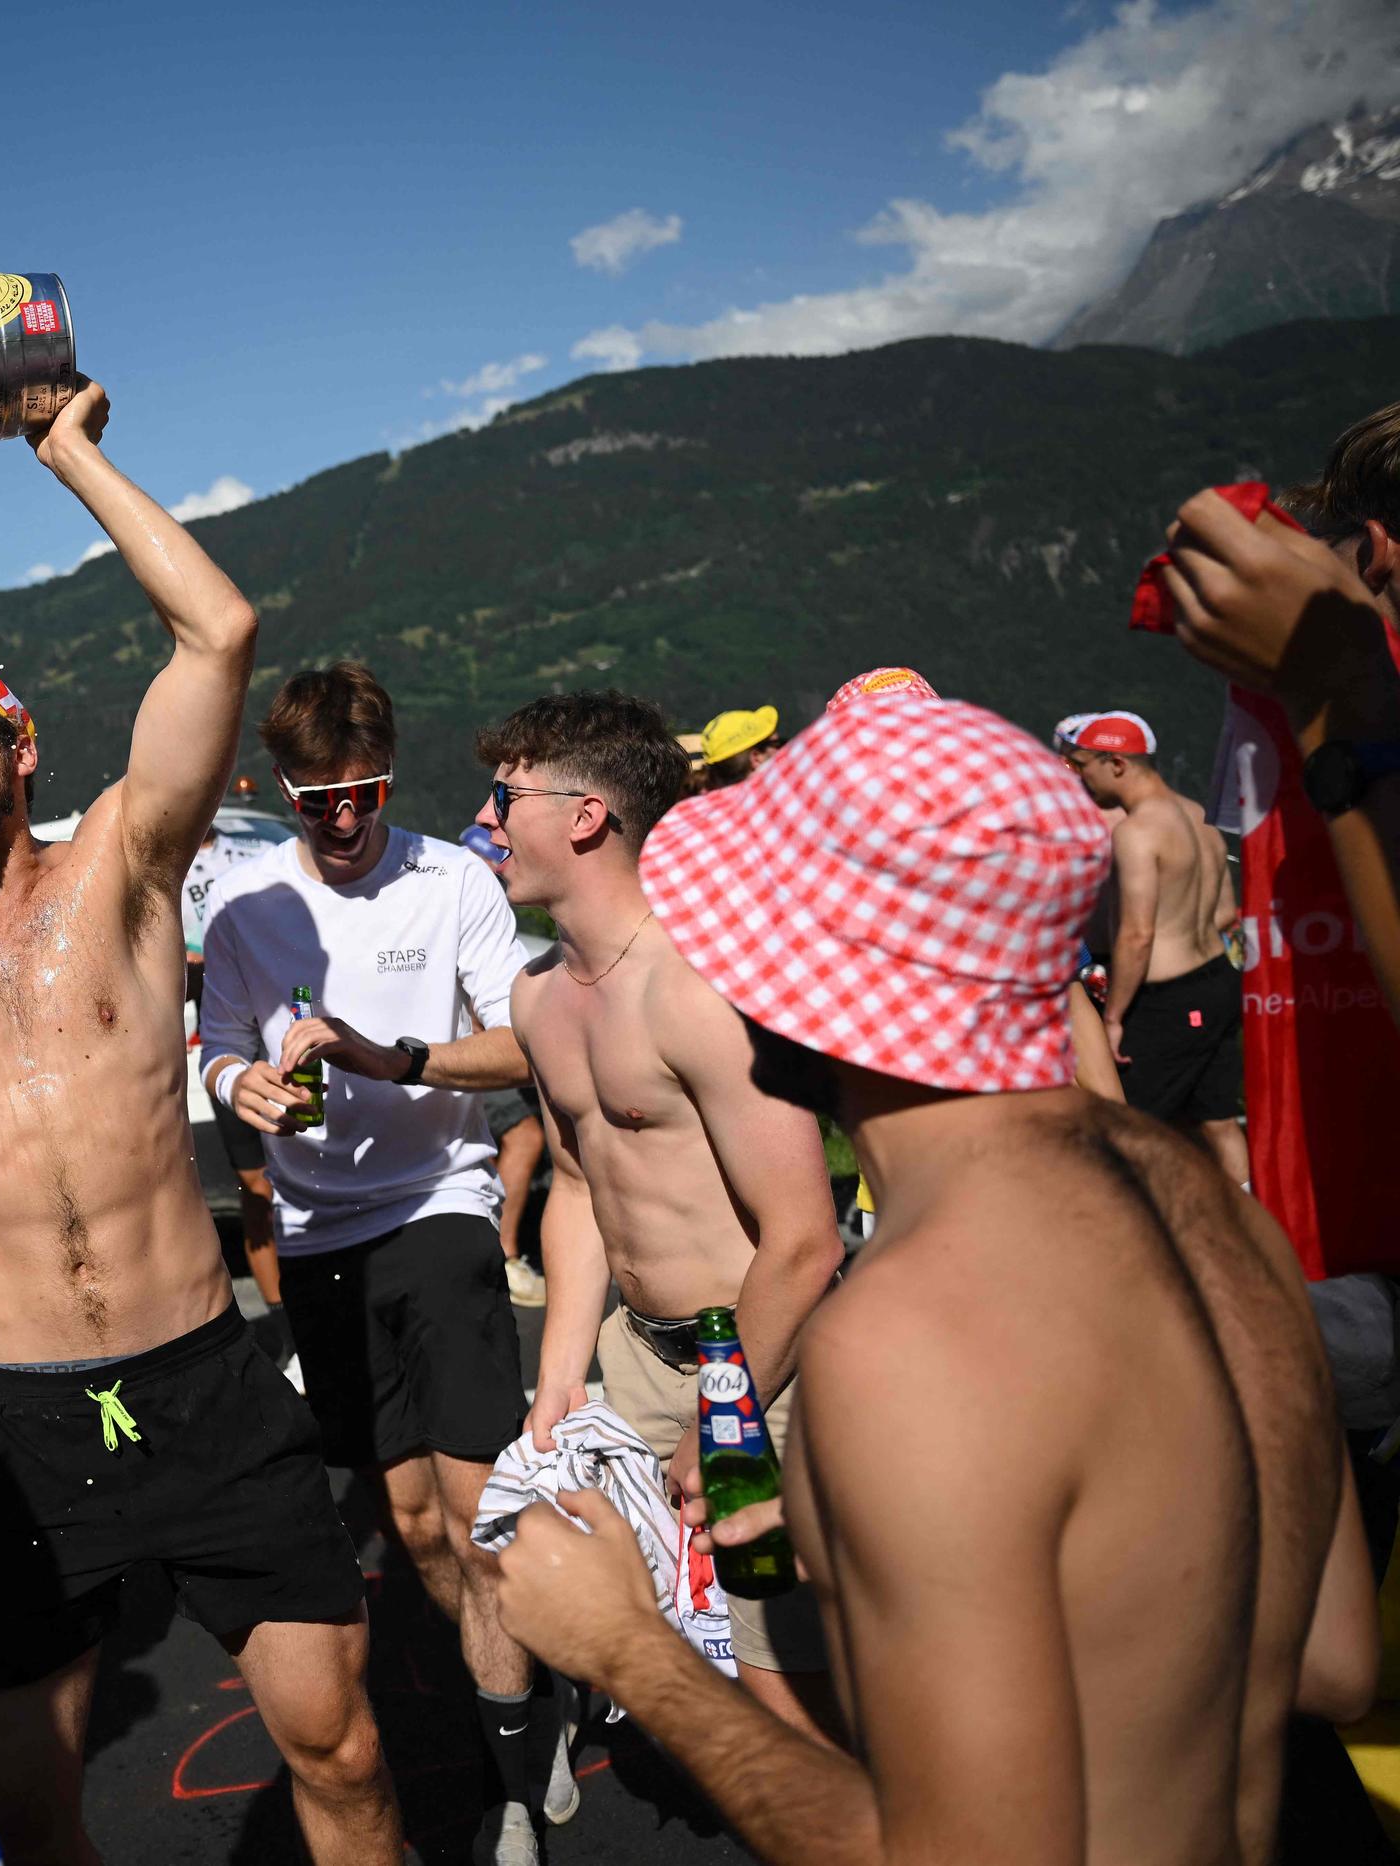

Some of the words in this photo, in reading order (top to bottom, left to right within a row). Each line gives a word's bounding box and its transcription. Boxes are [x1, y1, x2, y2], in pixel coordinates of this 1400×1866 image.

[403, 861, 439, 874] CRAFT
[377, 948, 427, 965] STAPS
[377, 962, 427, 974] CHAMBERY
